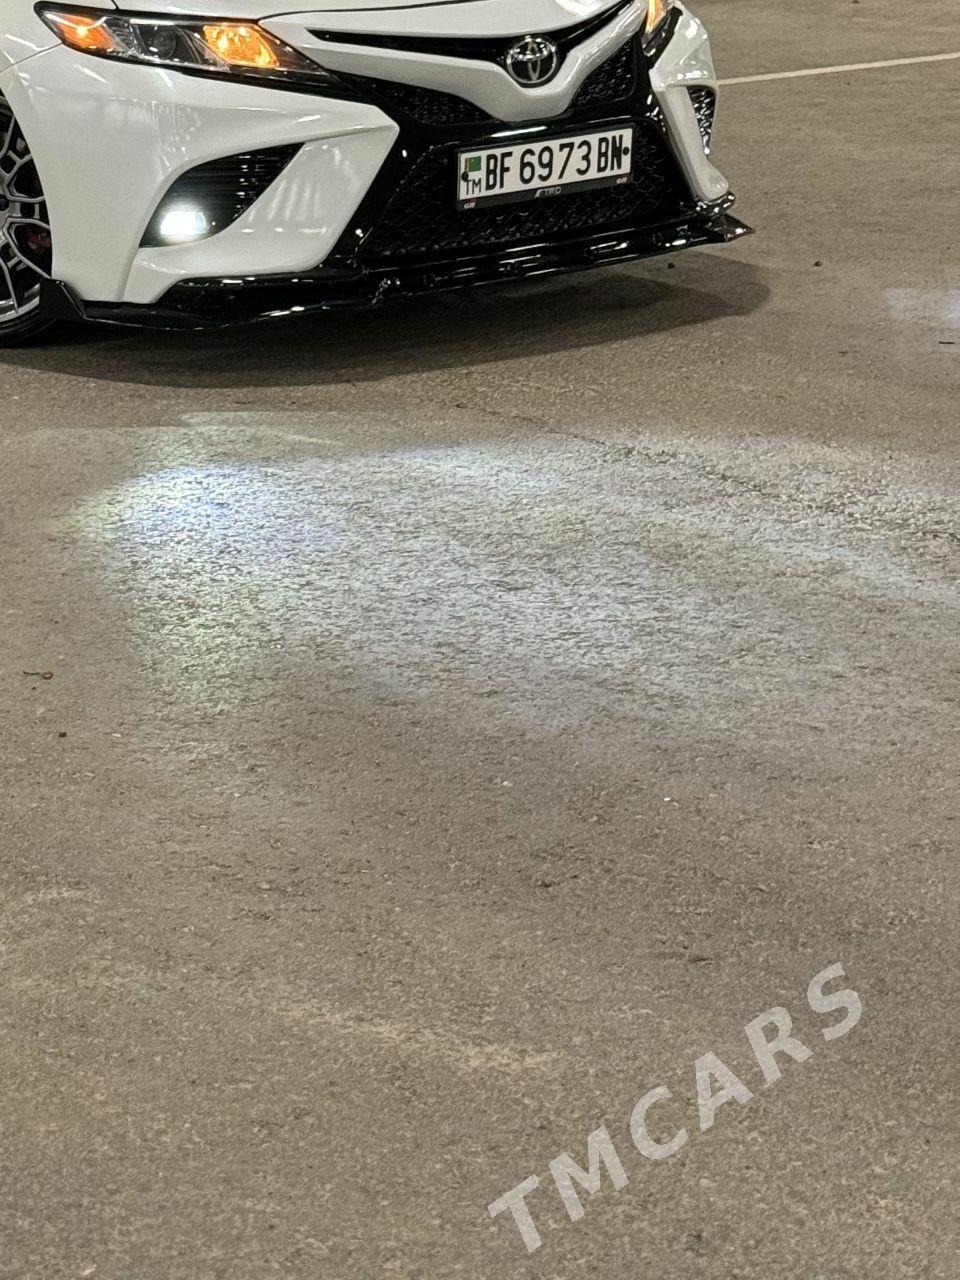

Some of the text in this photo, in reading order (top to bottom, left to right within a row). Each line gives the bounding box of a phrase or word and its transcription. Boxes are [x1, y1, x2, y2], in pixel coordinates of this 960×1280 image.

[485, 134, 623, 191] BF 6973 BN
[465, 178, 482, 196] TM
